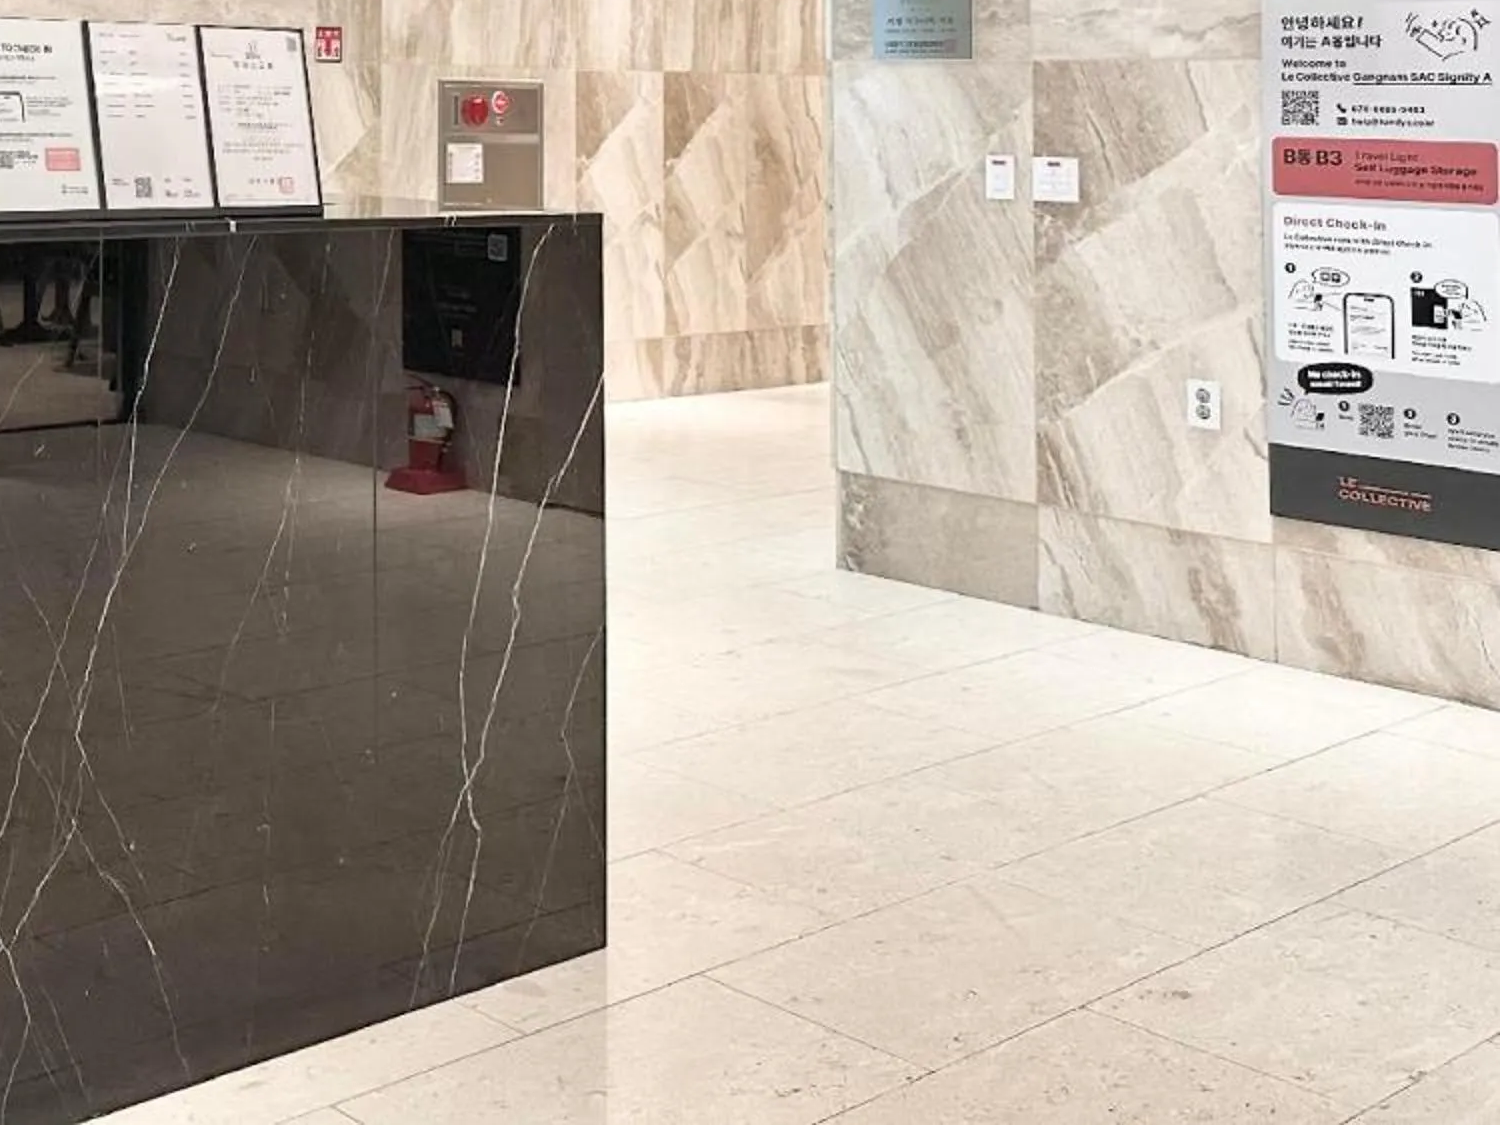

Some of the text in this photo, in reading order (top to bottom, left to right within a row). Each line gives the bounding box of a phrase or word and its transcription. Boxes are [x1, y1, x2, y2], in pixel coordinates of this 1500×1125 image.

[1281, 15, 1364, 30] 안녕하세요!
[1281, 34, 1383, 49] 여기는 A동입니다
[1281, 58, 1347, 69] Welcome to
[1281, 72, 1294, 82] Le
[1296, 72, 1351, 82] Collective
[1352, 72, 1408, 84] Gangnam
[1410, 72, 1435, 82] SAC
[1483, 72, 1493, 82] A
[1283, 148, 1343, 166] B동 B3
[1379, 163, 1429, 177] Luggage
[1430, 165, 1477, 179] Storage
[1283, 216, 1387, 231] Direct Check-in
[1339, 476, 1358, 488] LE
[1338, 489, 1433, 512] COLLECTIVE
